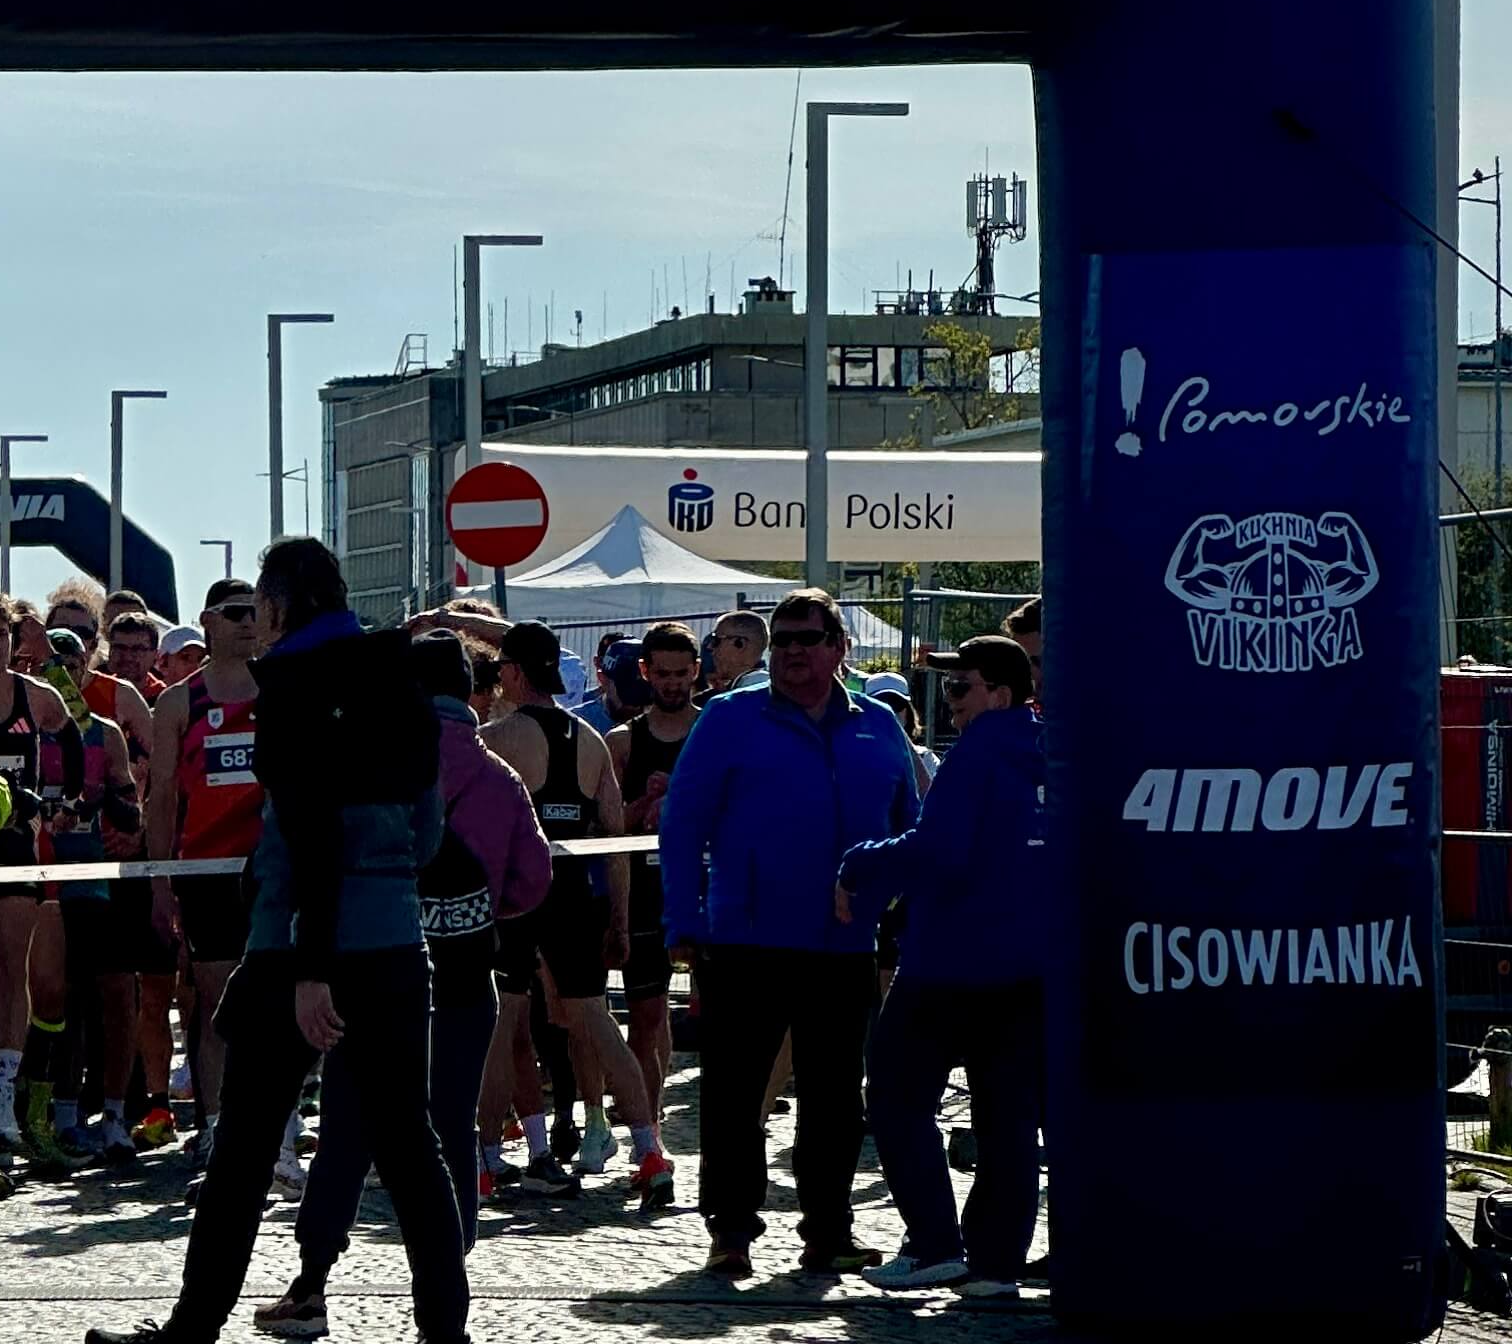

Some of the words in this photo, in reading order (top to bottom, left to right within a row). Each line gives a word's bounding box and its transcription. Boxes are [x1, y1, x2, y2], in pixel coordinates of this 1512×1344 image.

[734, 491, 805, 529] Ban
[846, 493, 954, 530] Polski
[1236, 513, 1317, 547] KUCHNIA
[1187, 607, 1363, 672] VIKINGA
[1123, 762, 1413, 832] 4MOVE
[1124, 915, 1422, 994] CISOWIANKA
